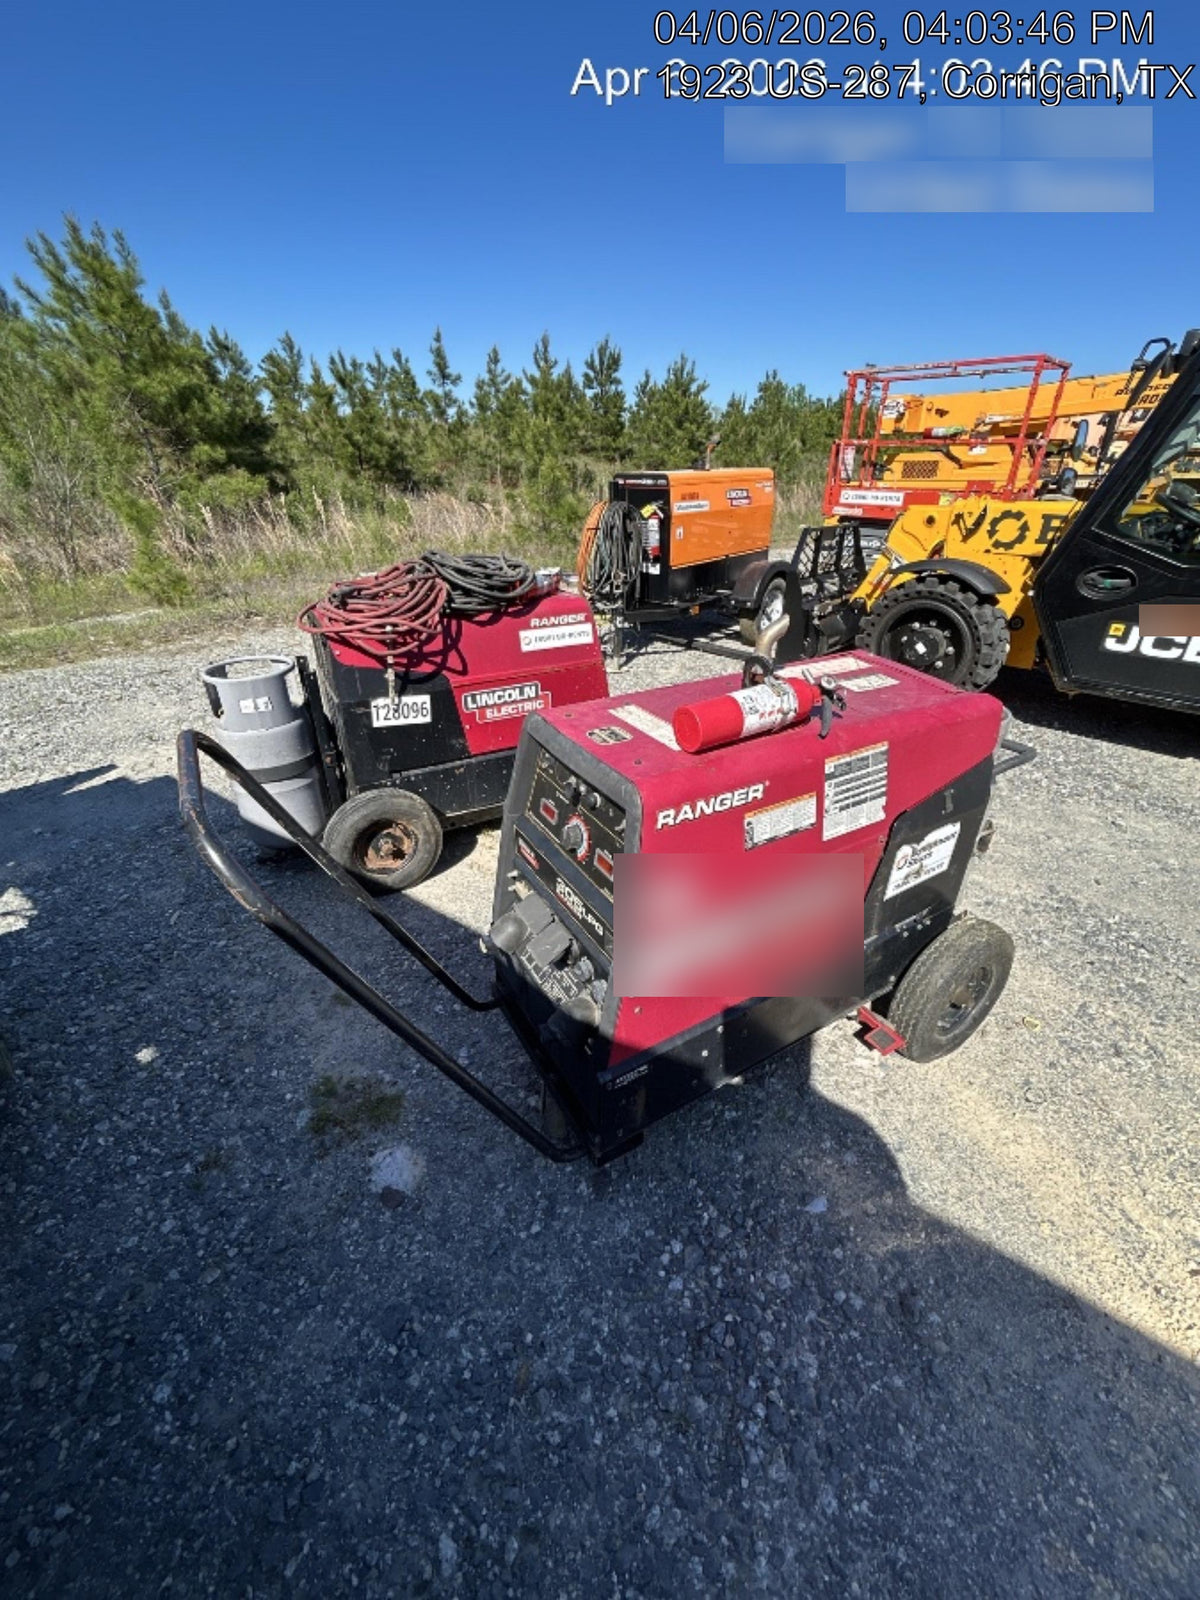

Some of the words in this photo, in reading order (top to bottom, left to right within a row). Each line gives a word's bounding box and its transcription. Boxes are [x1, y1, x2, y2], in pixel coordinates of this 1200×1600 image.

[530, 613, 588, 628] RANGER
[465, 684, 537, 710] LINCOLN
[486, 700, 545, 719] ELECTRIC
[656, 783, 766, 830] RANGER
